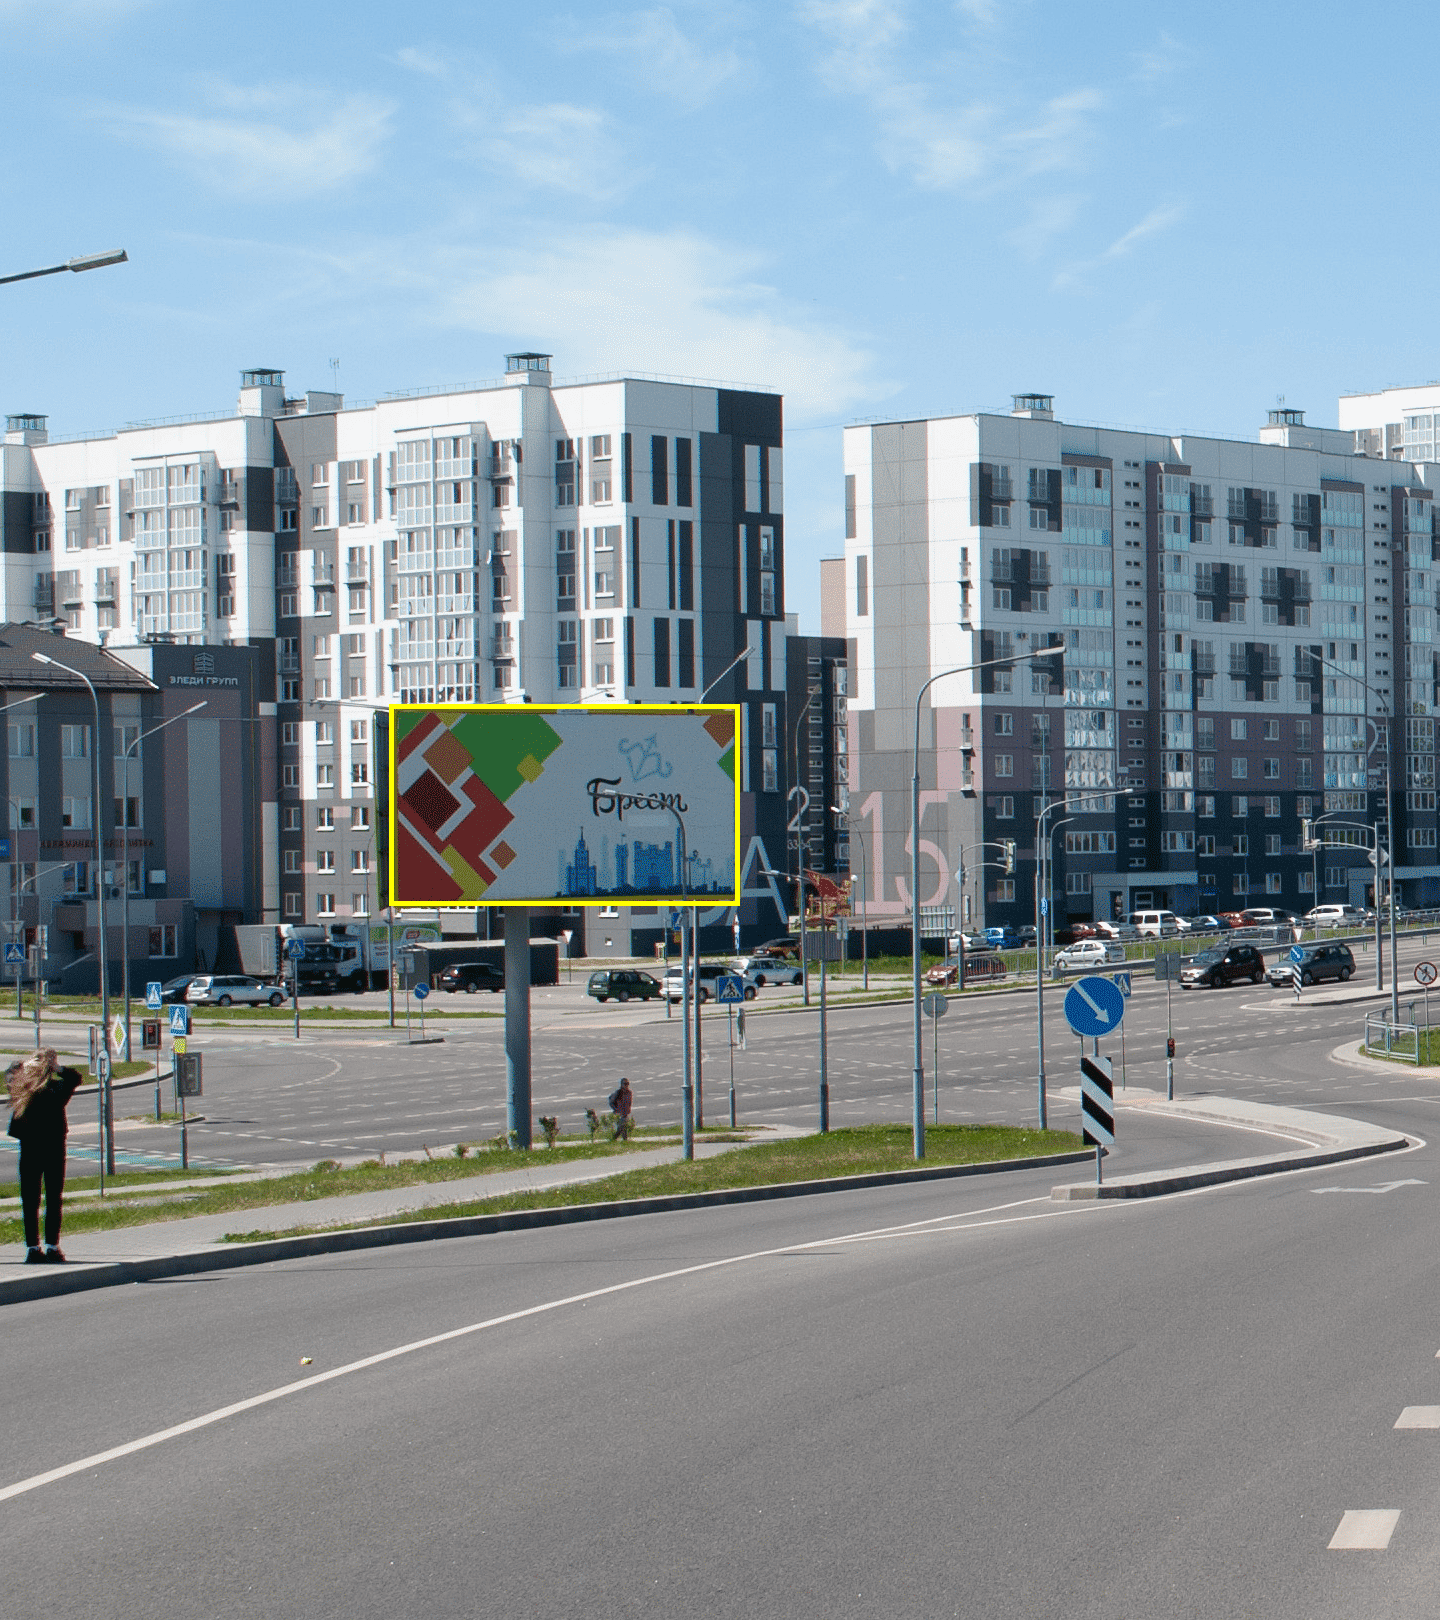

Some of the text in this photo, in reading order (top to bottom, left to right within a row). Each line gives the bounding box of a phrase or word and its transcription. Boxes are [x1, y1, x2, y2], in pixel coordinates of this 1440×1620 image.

[169, 676, 238, 686] ЭЛЕДИ ГРУПП
[587, 777, 688, 821] Брест
[787, 786, 811, 831] 2
[855, 790, 950, 915] 15
